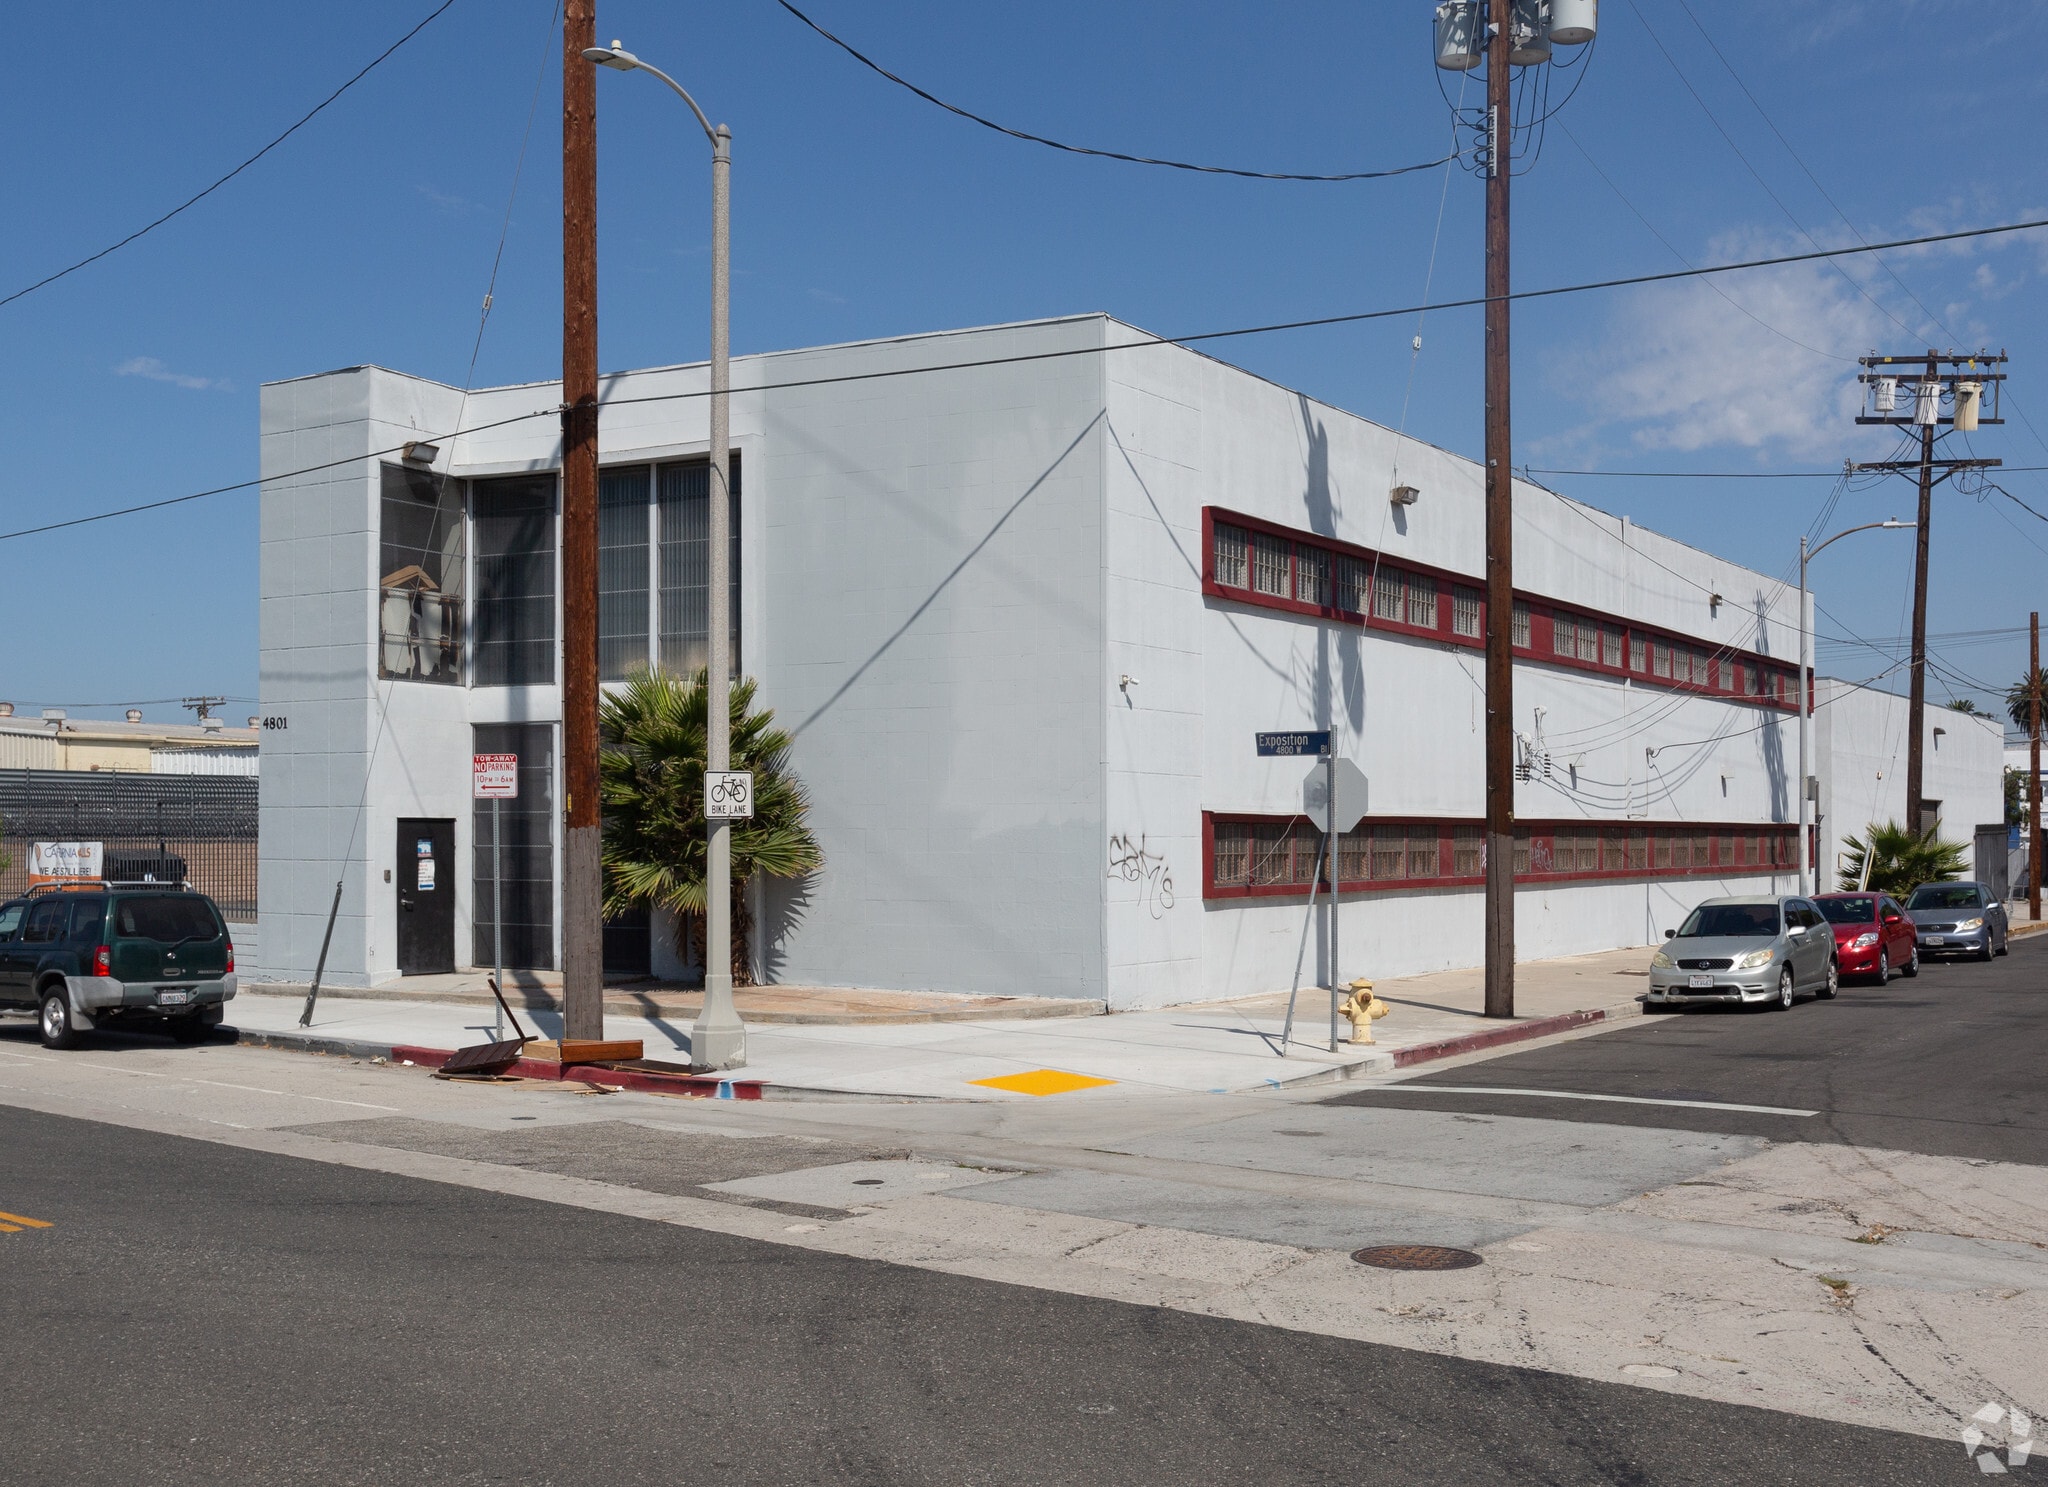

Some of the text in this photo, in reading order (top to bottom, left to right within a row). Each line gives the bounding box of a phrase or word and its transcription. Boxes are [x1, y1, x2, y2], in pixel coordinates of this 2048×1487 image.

[263, 716, 288, 730] 4801
[1259, 734, 1309, 749] Exposition
[1276, 746, 1294, 754] 4800
[1296, 746, 1302, 754] W
[474, 762, 514, 772] NO PARKING
[476, 775, 493, 783] 10PM
[500, 775, 514, 783] 6AM
[711, 805, 747, 814] BIKE LANE
